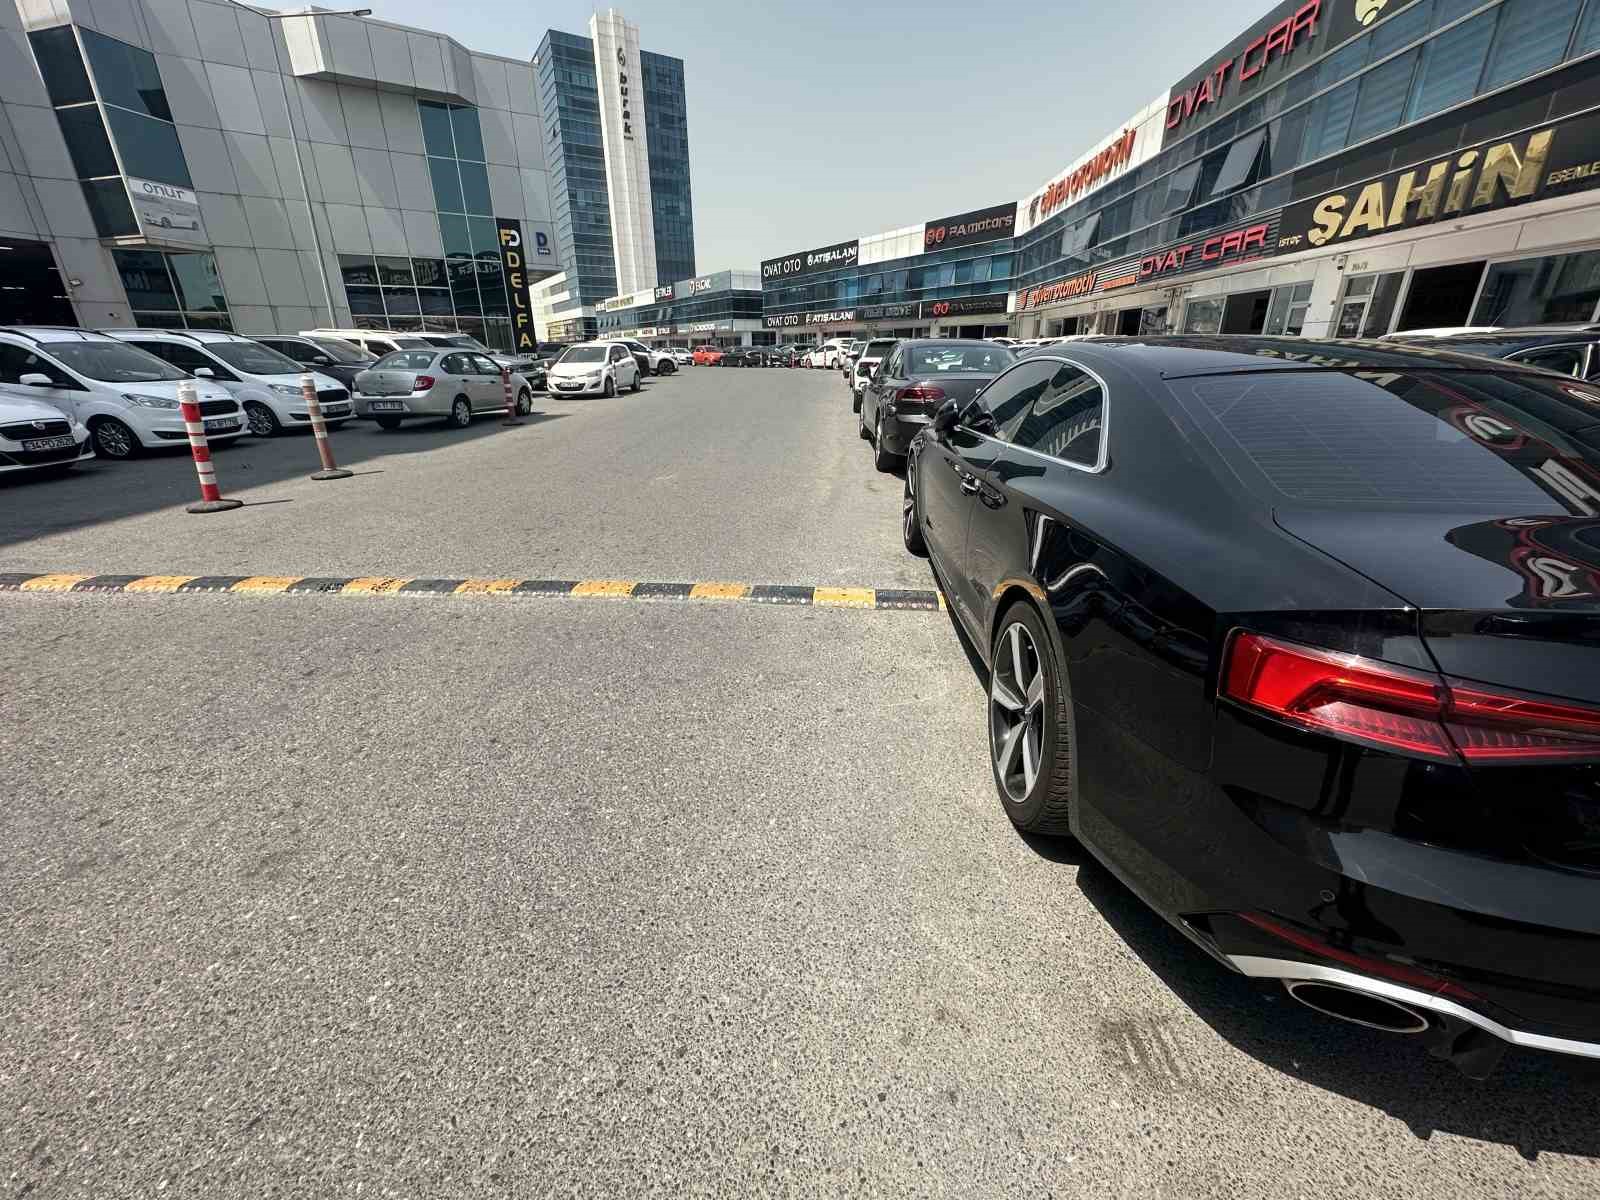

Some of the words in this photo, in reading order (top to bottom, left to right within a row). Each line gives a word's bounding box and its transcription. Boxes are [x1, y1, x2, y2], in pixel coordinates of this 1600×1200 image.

[1167, 60, 1233, 130] OVAT
[1239, 0, 1320, 82] CAR
[619, 71, 632, 134] burak
[763, 262, 781, 277] OVAT
[783, 258, 801, 273] OTO
[1139, 245, 1192, 276] OVAT
[1202, 223, 1269, 262] CAR
[506, 251, 533, 348] DELFA
[767, 316, 782, 327] OVAT
[784, 315, 799, 326] OTO
